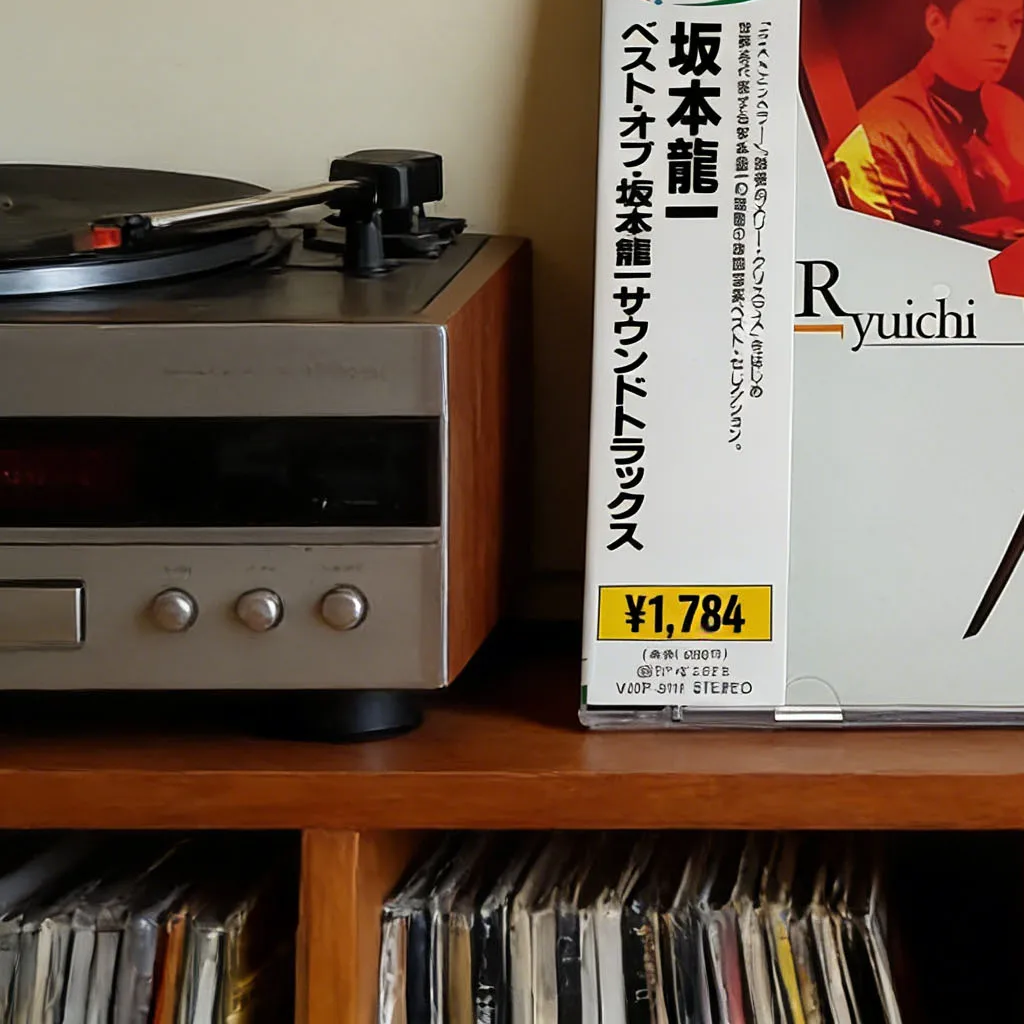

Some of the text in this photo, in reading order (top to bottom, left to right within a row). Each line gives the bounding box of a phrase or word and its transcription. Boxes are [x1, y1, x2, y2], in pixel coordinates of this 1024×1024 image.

[665, 21, 722, 219] 坂本龍一
[795, 260, 977, 352] Ryuichi
[625, 594, 745, 638] ¥1,784
